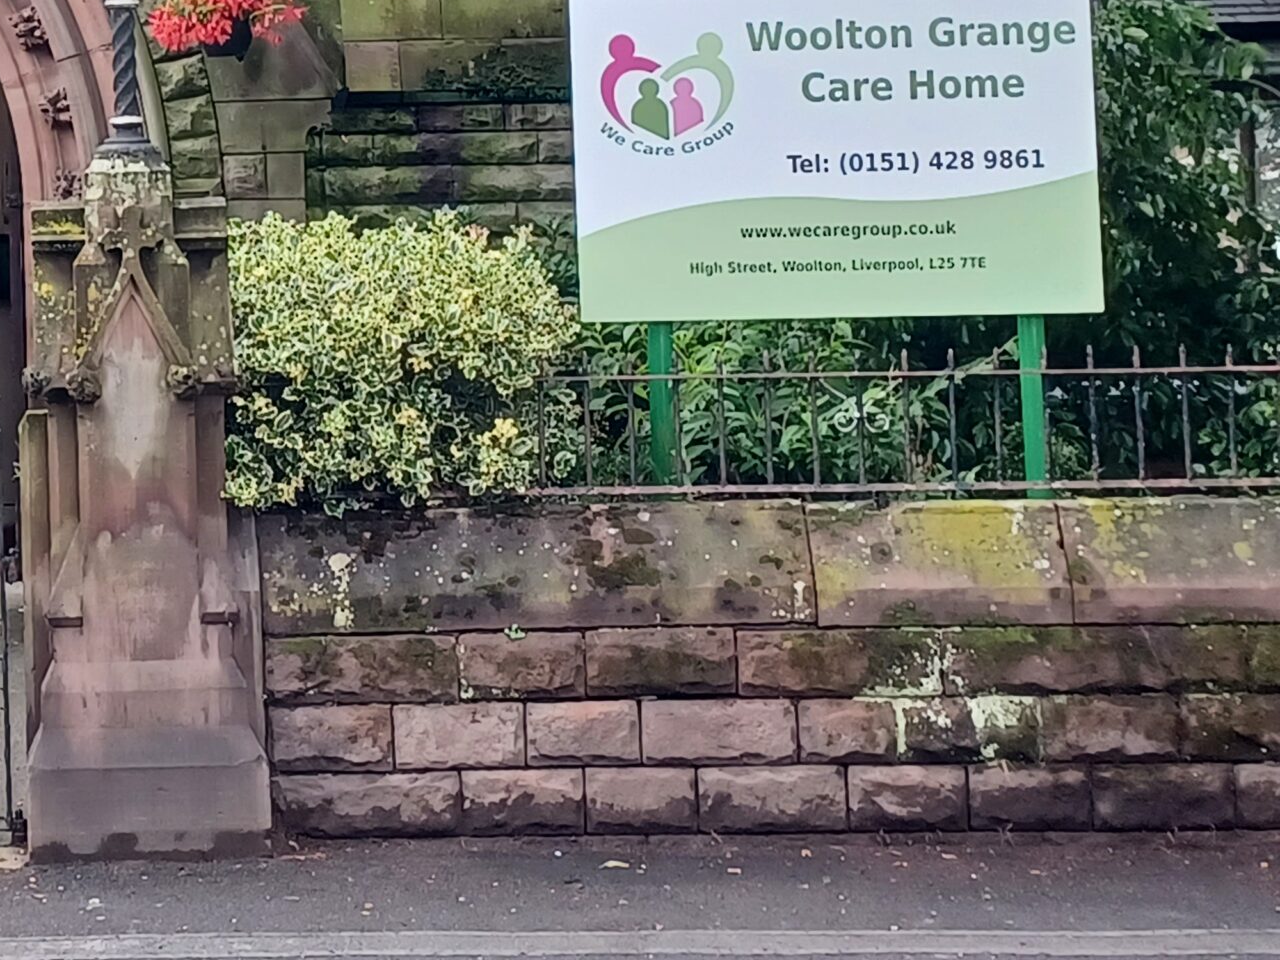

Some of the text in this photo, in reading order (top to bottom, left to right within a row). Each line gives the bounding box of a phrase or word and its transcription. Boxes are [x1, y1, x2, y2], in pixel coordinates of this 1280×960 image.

[745, 16, 1076, 53] Woolton Grange
[801, 69, 1025, 102] Care Home
[600, 121, 734, 156] We Care Group
[786, 149, 1045, 175] Tel: (0151) 428 9861
[740, 220, 957, 240] www.wecaregroup.co.uk
[689, 256, 987, 277] High Street, Woolton, Liverpool, L25 7TE
